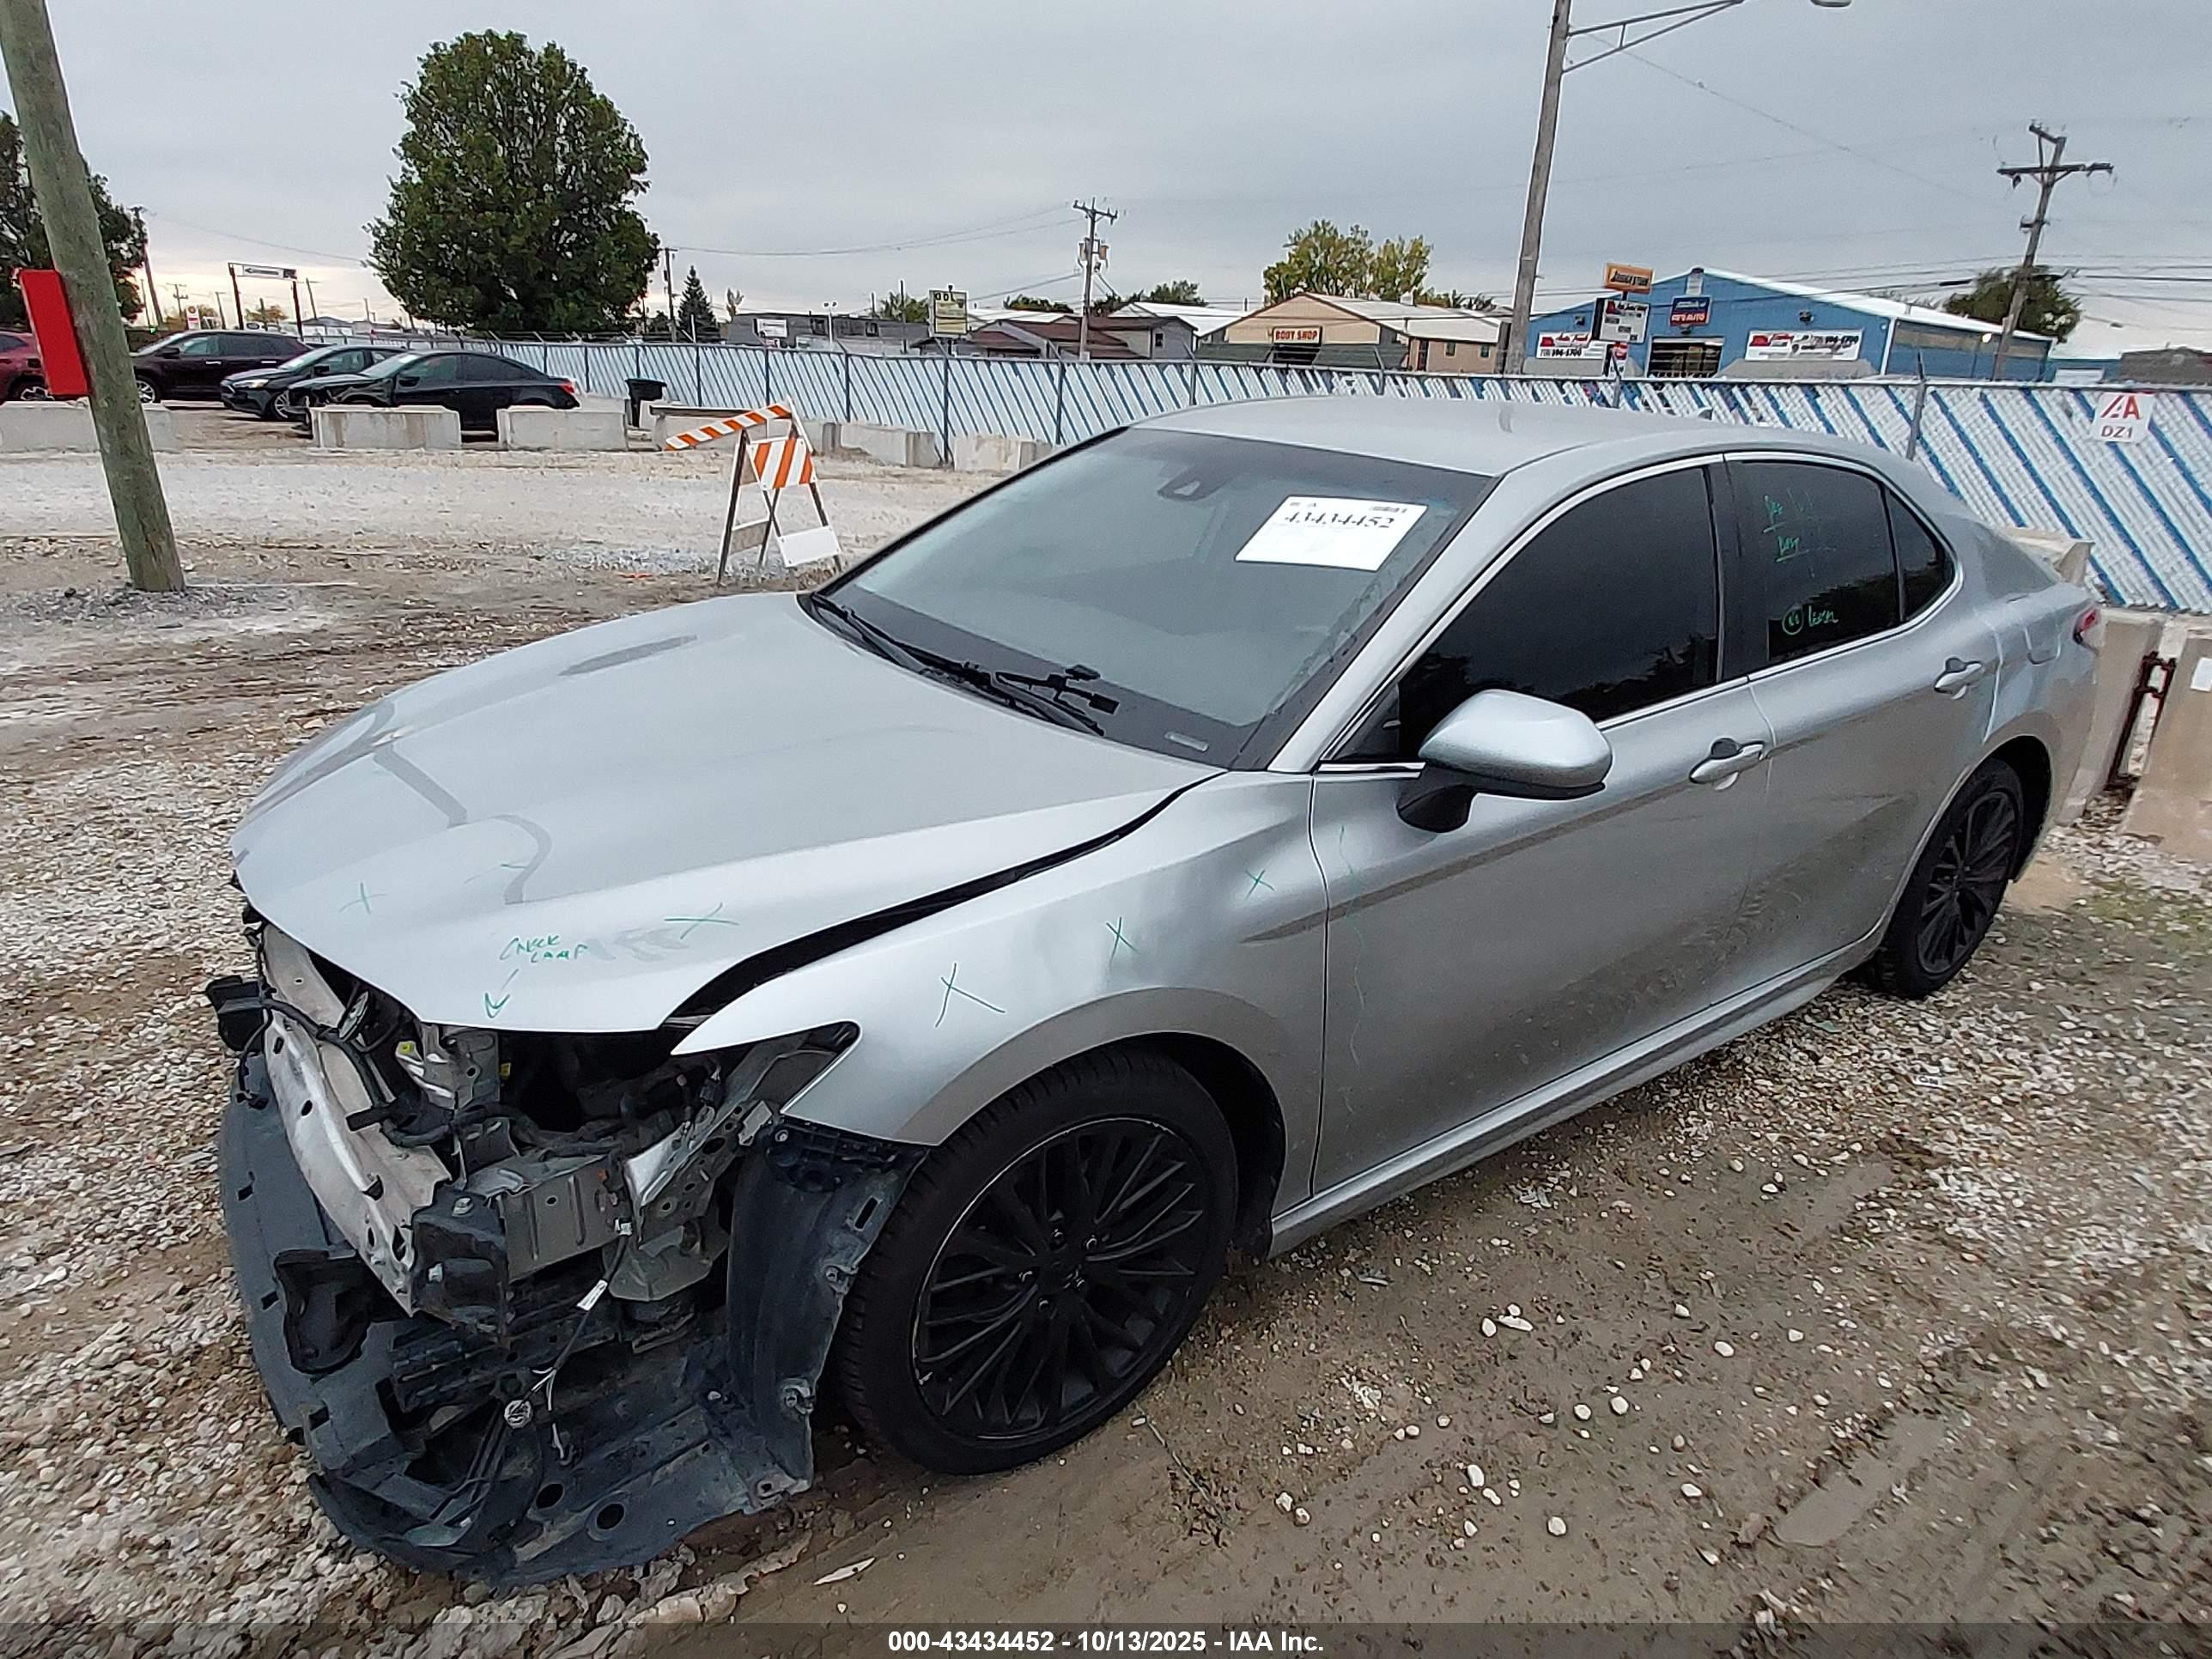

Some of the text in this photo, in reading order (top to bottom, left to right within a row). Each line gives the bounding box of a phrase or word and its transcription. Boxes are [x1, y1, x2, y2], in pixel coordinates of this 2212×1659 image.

[2100, 424, 2134, 439] DZ1
[1285, 511, 1395, 529] 43434452
[499, 934, 560, 961] CHECK
